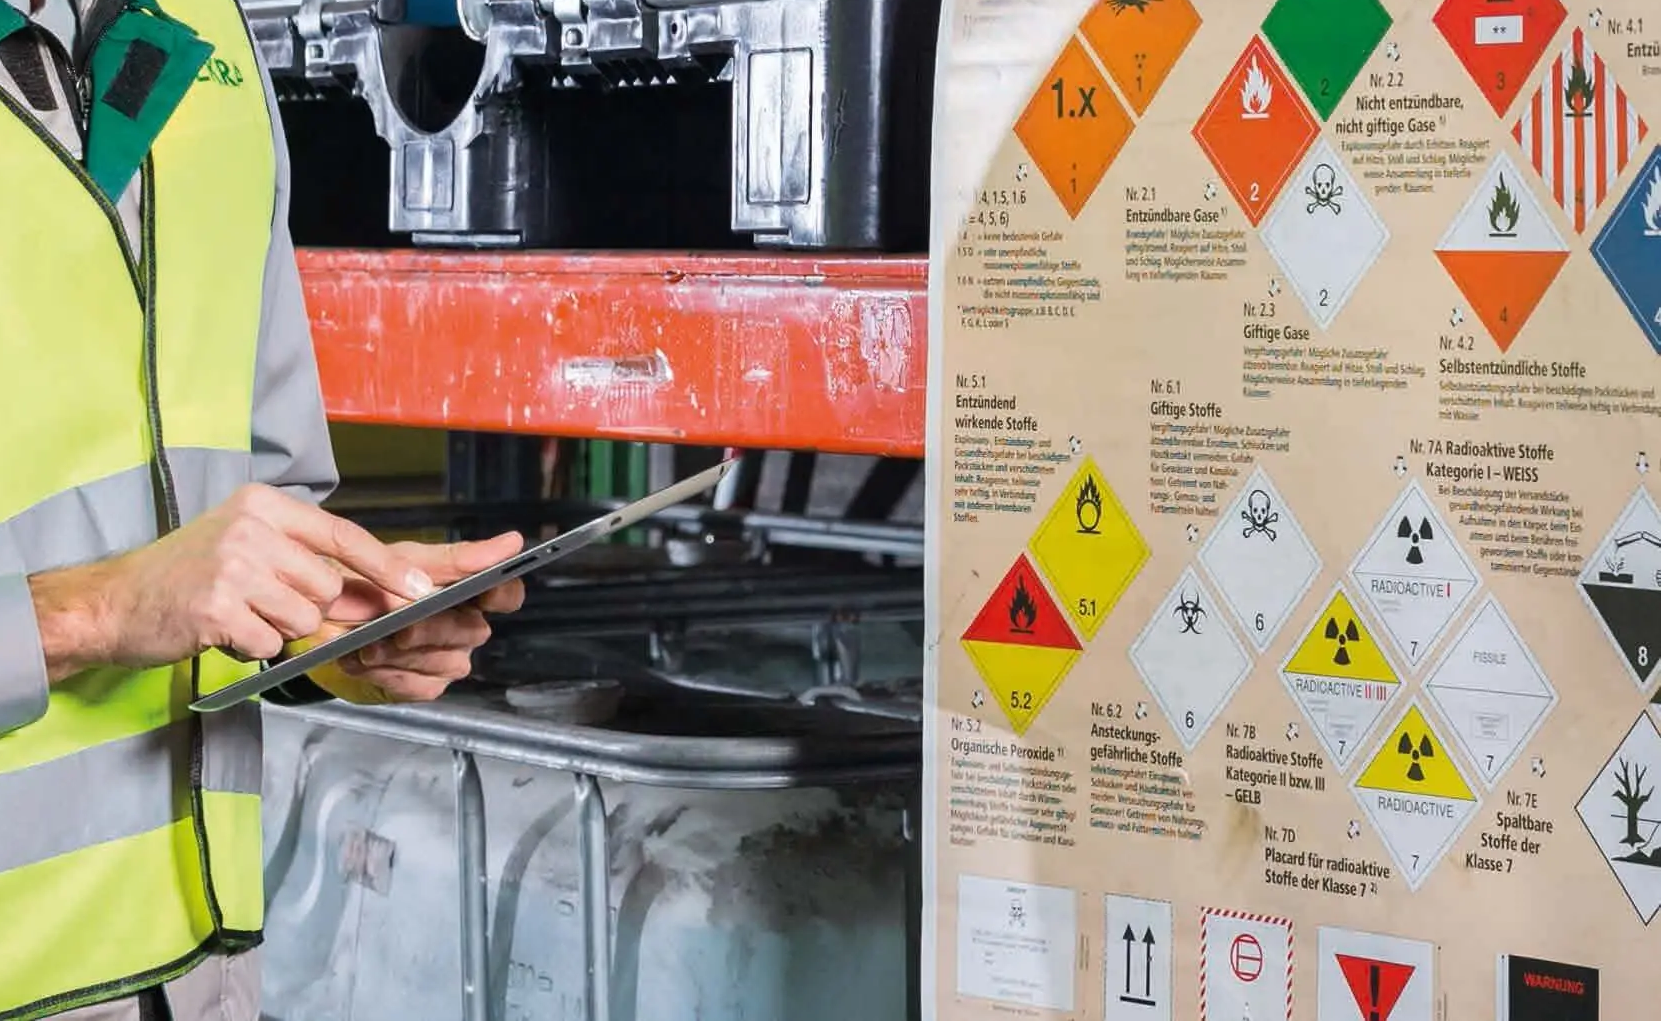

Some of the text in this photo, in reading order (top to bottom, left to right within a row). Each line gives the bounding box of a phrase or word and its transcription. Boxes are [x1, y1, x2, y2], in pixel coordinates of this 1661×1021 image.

[1607, 18, 1643, 35] Nr. 4.1
[1627, 41, 1660, 58] Entzü
[198, 58, 244, 87] KRA
[1370, 72, 1404, 88] Nr. 2.2
[1496, 71, 1506, 90] 3
[1320, 78, 1330, 96] 2
[1050, 76, 1097, 119] 1.x
[1355, 93, 1465, 111] Nicht entzündbare,
[1335, 119, 1364, 134] nicht
[1366, 118, 1405, 137] giftige
[1407, 117, 1436, 133] Gase
[992, 189, 1008, 206] 1.5,
[1012, 189, 1027, 205] 1.6
[1125, 187, 1156, 201] Nr. 2.1
[1250, 182, 1260, 201] 2
[978, 212, 988, 227] 4,
[989, 212, 998, 227] 5,
[999, 211, 1010, 228] 6)
[1126, 207, 1191, 223] Entzündbare
[1193, 209, 1219, 223] Gase
[1319, 288, 1328, 307] 2
[1243, 302, 1276, 317] Nr. 2.3
[1499, 307, 1508, 323] 4
[1243, 325, 1310, 343] Giftige Gase
[1439, 335, 1474, 351] Nr. 4.2
[1439, 358, 1587, 378] Selbstentzündliche Stoffe
[956, 375, 986, 389] Nr. 5.1
[1150, 380, 1181, 395] Nr. 6.1
[955, 394, 1017, 410] Entzündend
[1150, 401, 1222, 420] Giftige Stoffe
[955, 414, 1038, 431] wirkende Stoffe
[1410, 439, 1555, 461] Nr. 7A Radioaktive Stoffe
[1426, 462, 1484, 482] Kategorie
[1487, 465, 1491, 480] I
[1503, 466, 1539, 482] WEISS
[1371, 579, 1444, 598] RADIOACTIVE
[1078, 598, 1096, 617] 5.1
[1255, 613, 1265, 631] 6
[1410, 640, 1419, 657] 7
[1472, 651, 1507, 665] FISSILE
[1638, 645, 1648, 666] 8
[1296, 678, 1363, 698] RADIOACTIVE
[1010, 690, 1032, 709] 5.2
[1091, 701, 1122, 719] Nr. 6.2
[1185, 710, 1195, 729] 6
[951, 717, 982, 732] Nr. 5.2
[1226, 723, 1257, 739] Nr. 7B
[1091, 723, 1161, 747] Ansteckungs-
[950, 737, 1008, 756] Organische
[1010, 744, 1056, 762] Peroxide
[1090, 744, 1183, 767] gefährliche Stoffe
[1226, 744, 1323, 769] Radioaktive Stoffe
[1338, 740, 1346, 755] 7
[1486, 754, 1494, 771] 7
[1226, 766, 1277, 787] Kategorie
[1289, 773, 1313, 790] bzw.
[1234, 789, 1261, 805] GELB
[1378, 795, 1454, 818] RADIOACTIVE
[1506, 790, 1538, 809] Nr. 7E
[1496, 811, 1553, 834] Spaltbare
[1265, 825, 1296, 843] Nr. 7D
[1480, 833, 1541, 855] Stoffe der
[1265, 847, 1390, 879] Placard für radioaktive
[1411, 853, 1420, 871] 7
[1465, 853, 1513, 874] Klasse 7
[1265, 869, 1299, 888] Stoffe
[1301, 874, 1320, 891] der
[1322, 877, 1357, 897] Klasse
[1359, 882, 1367, 898] 7
[1522, 970, 1585, 996] WARNUNG
